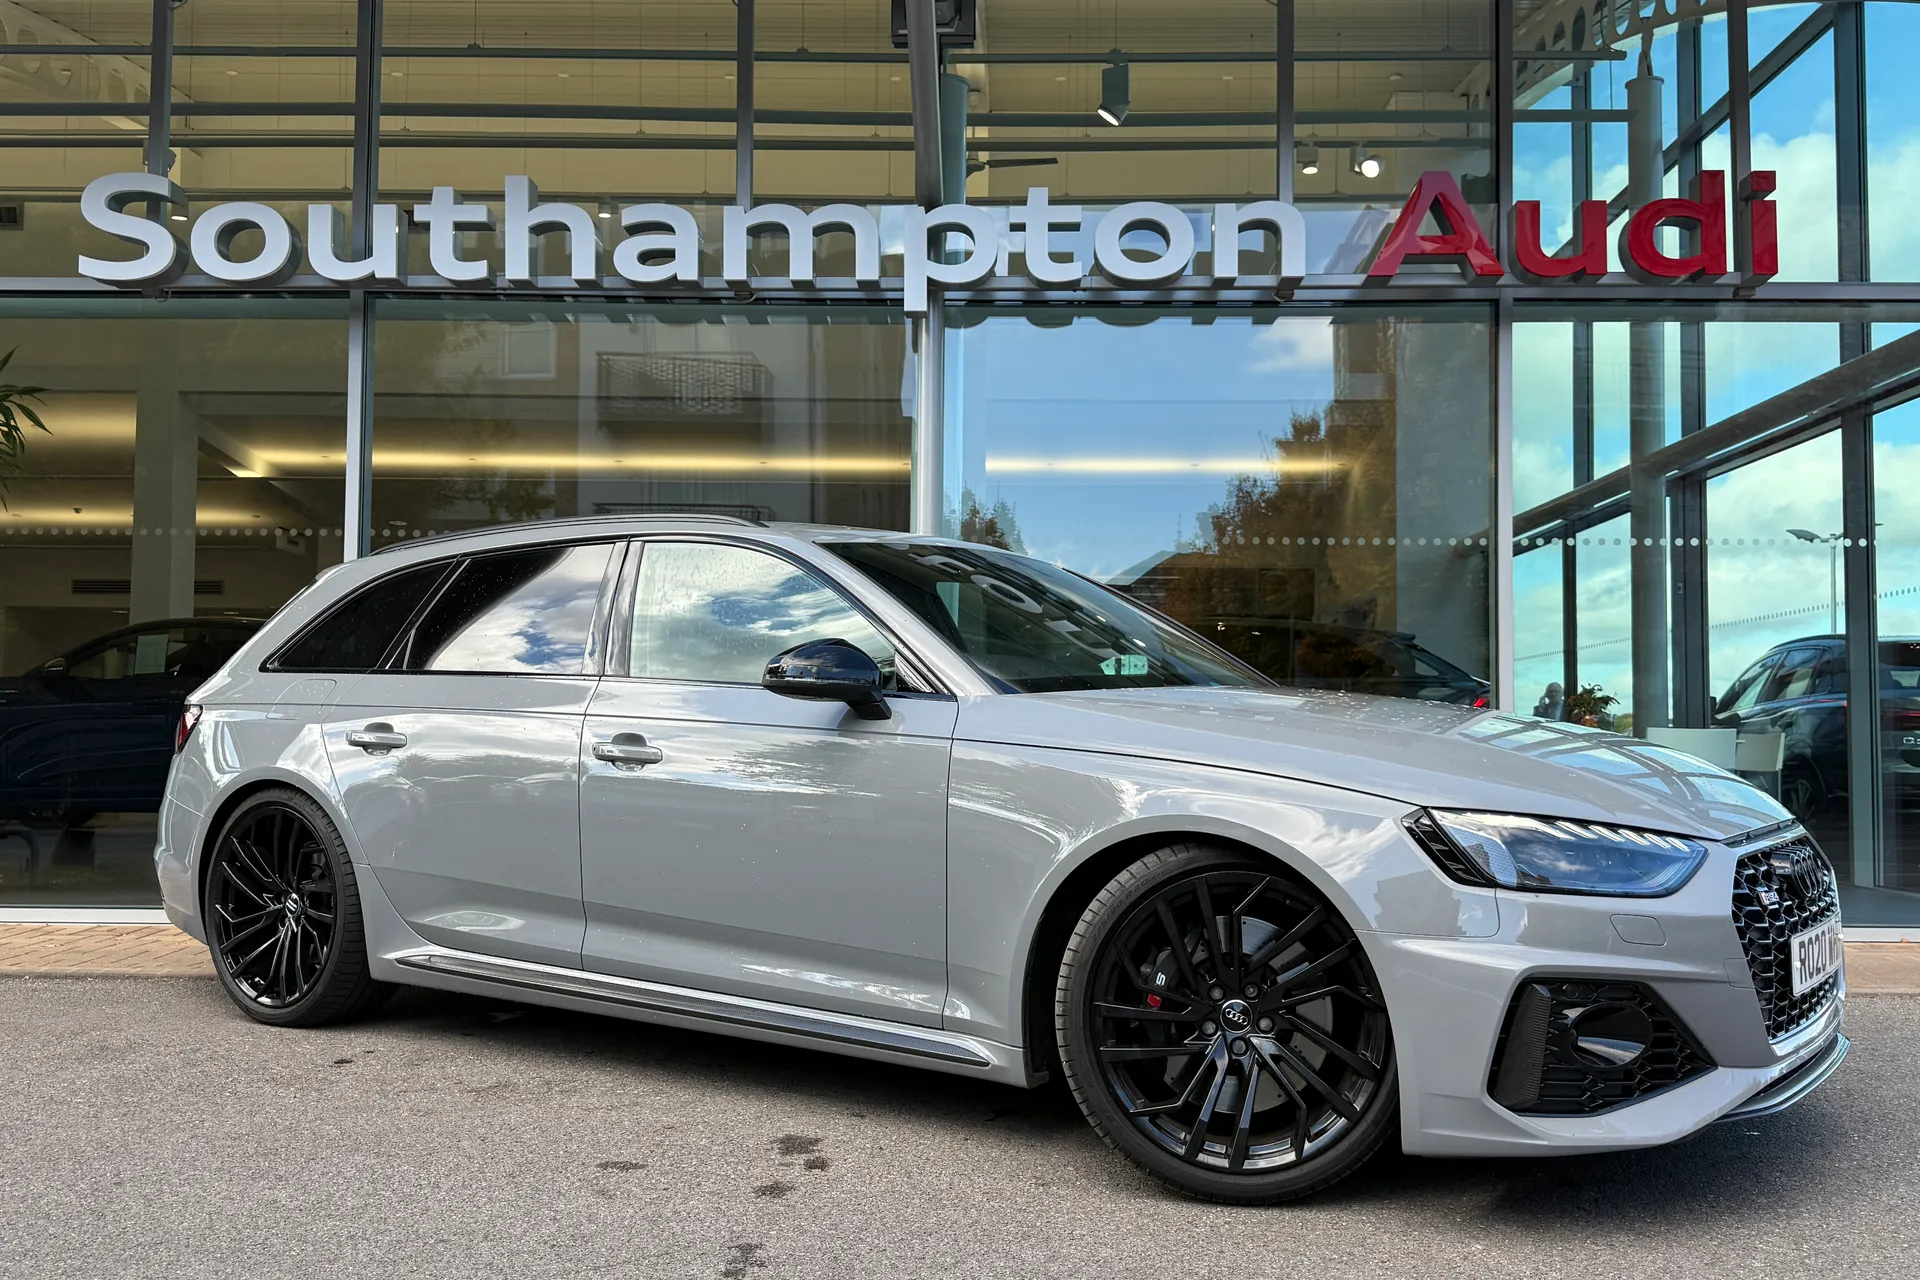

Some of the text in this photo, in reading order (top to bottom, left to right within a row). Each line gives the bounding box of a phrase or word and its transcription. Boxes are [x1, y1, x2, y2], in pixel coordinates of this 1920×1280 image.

[78, 169, 1778, 314] Southampton Audi
[1799, 929, 1827, 985] RO20
